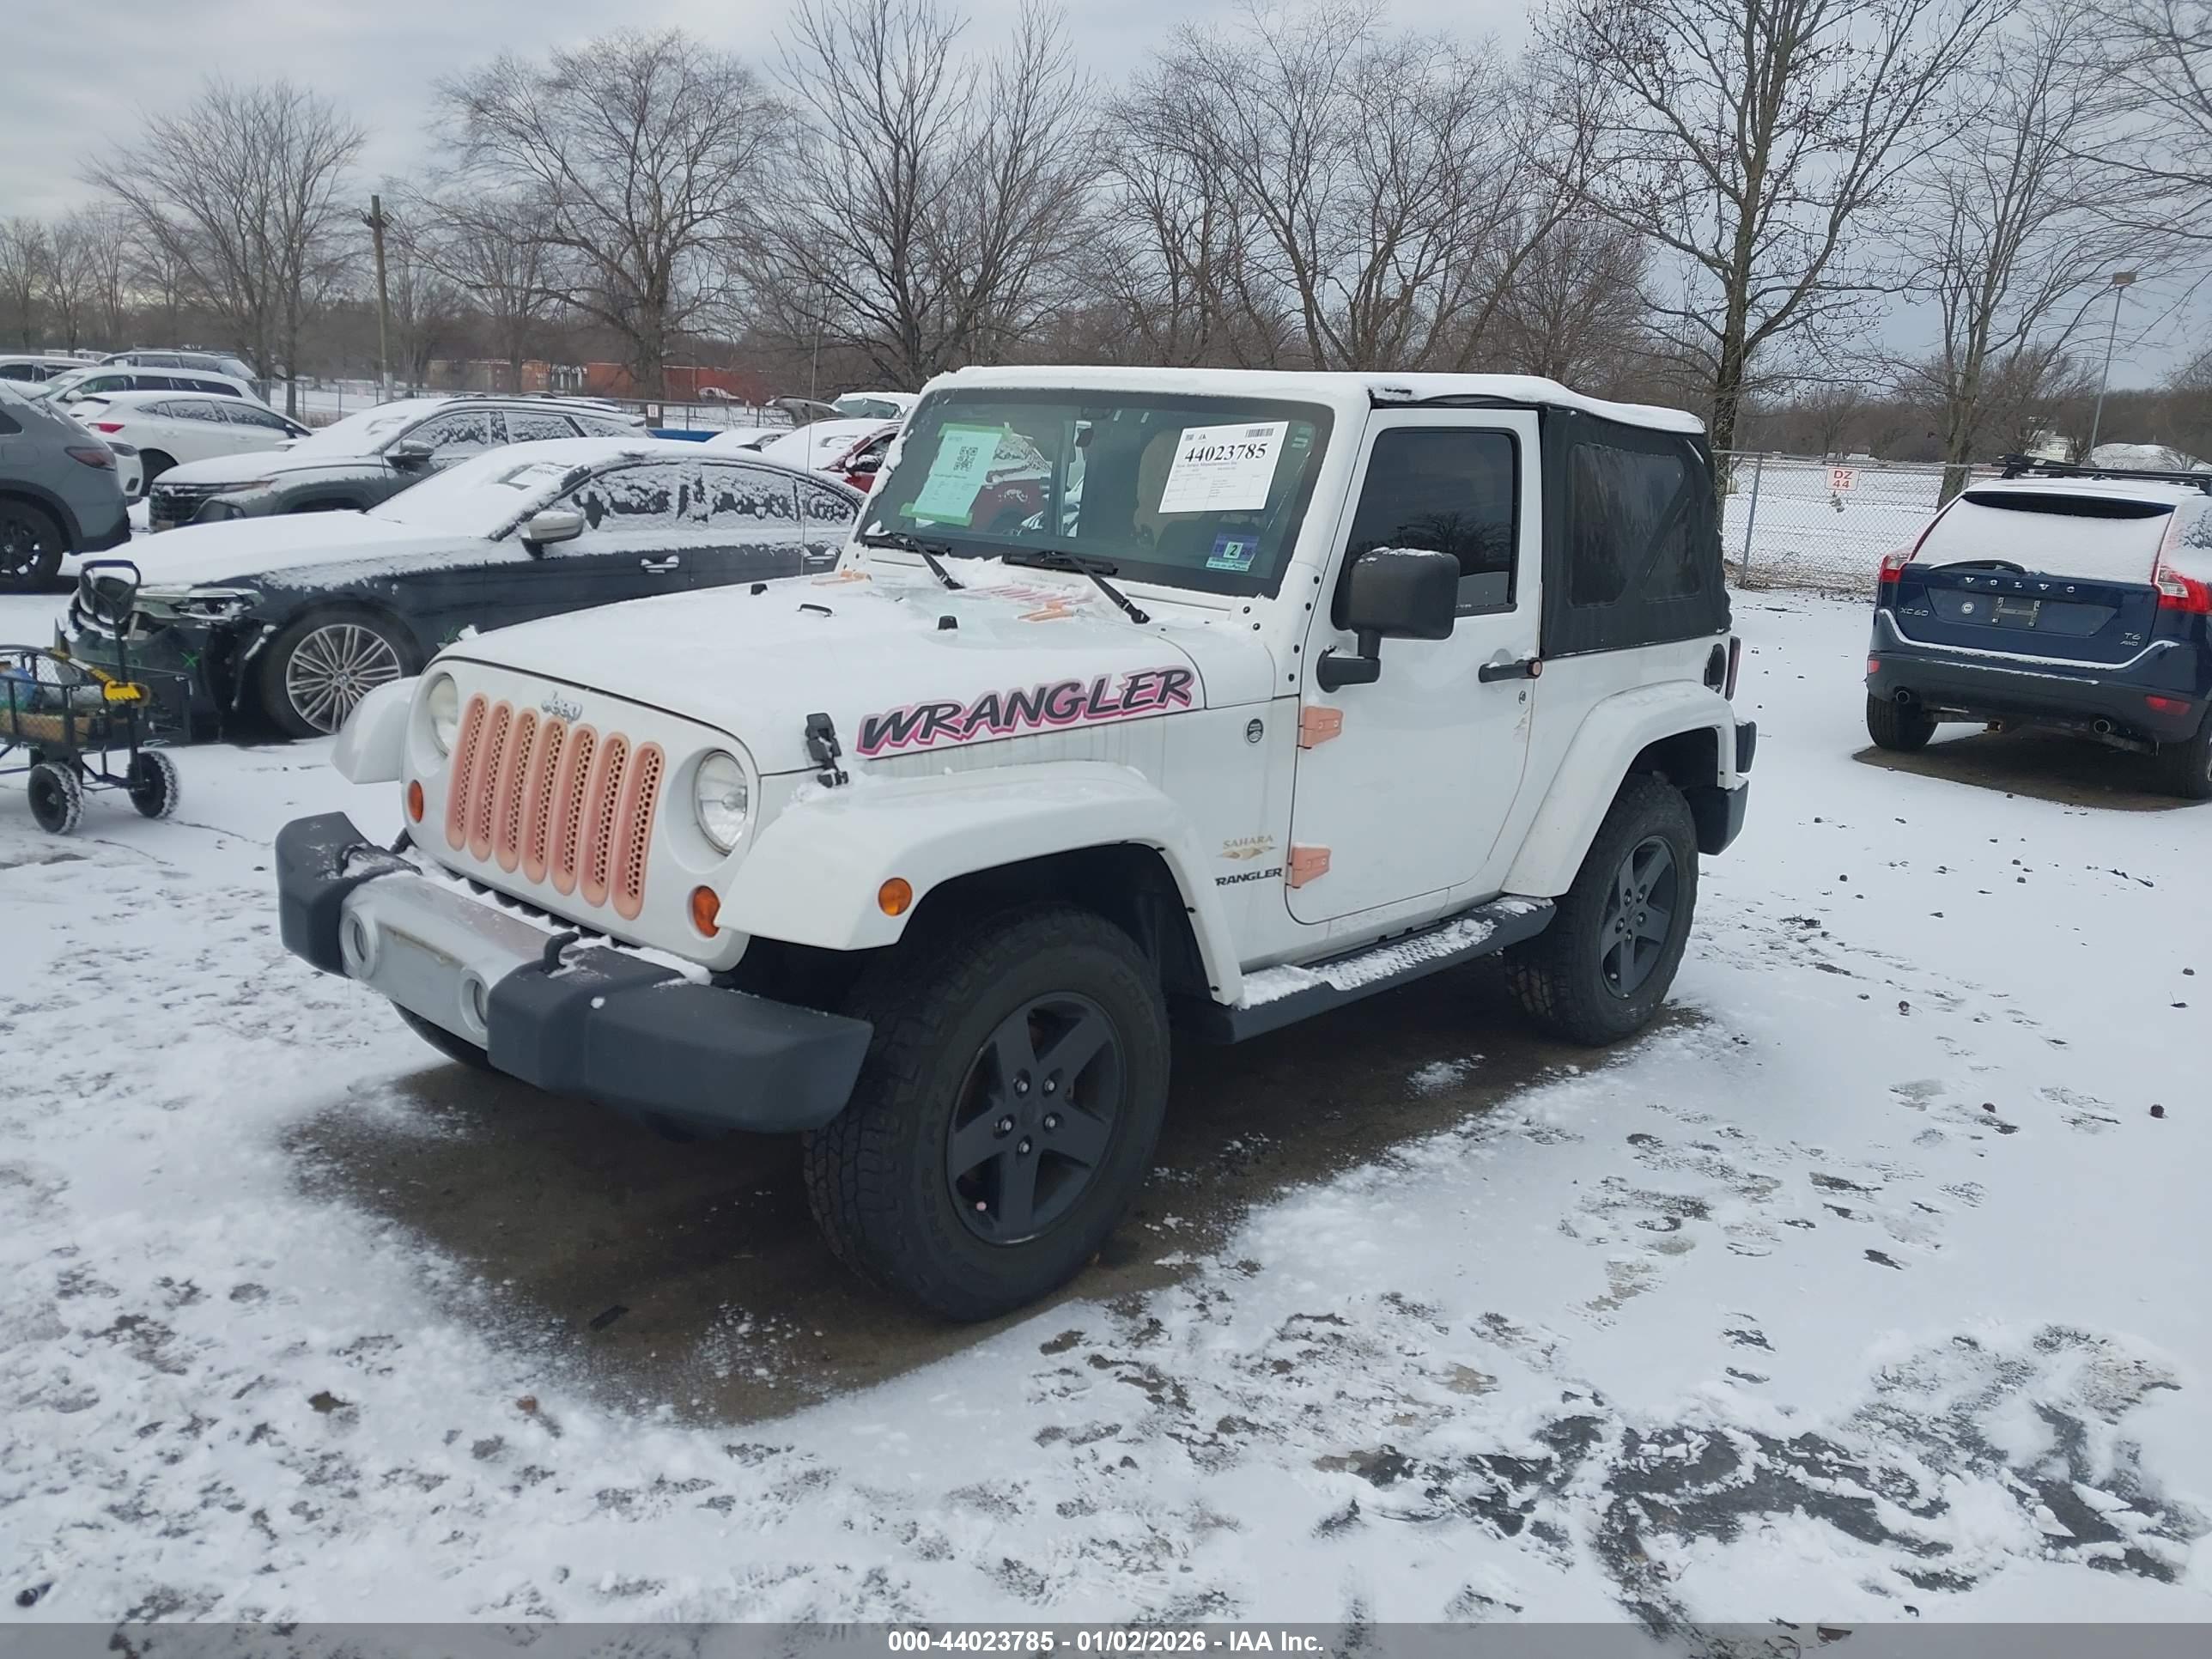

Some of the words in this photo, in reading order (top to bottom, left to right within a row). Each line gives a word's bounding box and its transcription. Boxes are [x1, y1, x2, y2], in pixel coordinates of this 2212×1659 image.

[1184, 442, 1268, 463] 44023785
[1833, 470, 1853, 480] DZ
[1832, 480, 1850, 489] 44
[1229, 544, 1238, 556] 2
[1964, 576, 2075, 592] VOLVO
[1900, 607, 1929, 617] XC60
[2124, 632, 2142, 641] T6
[859, 667, 1194, 755] WRANGLER
[1223, 834, 1273, 848] SAHARA
